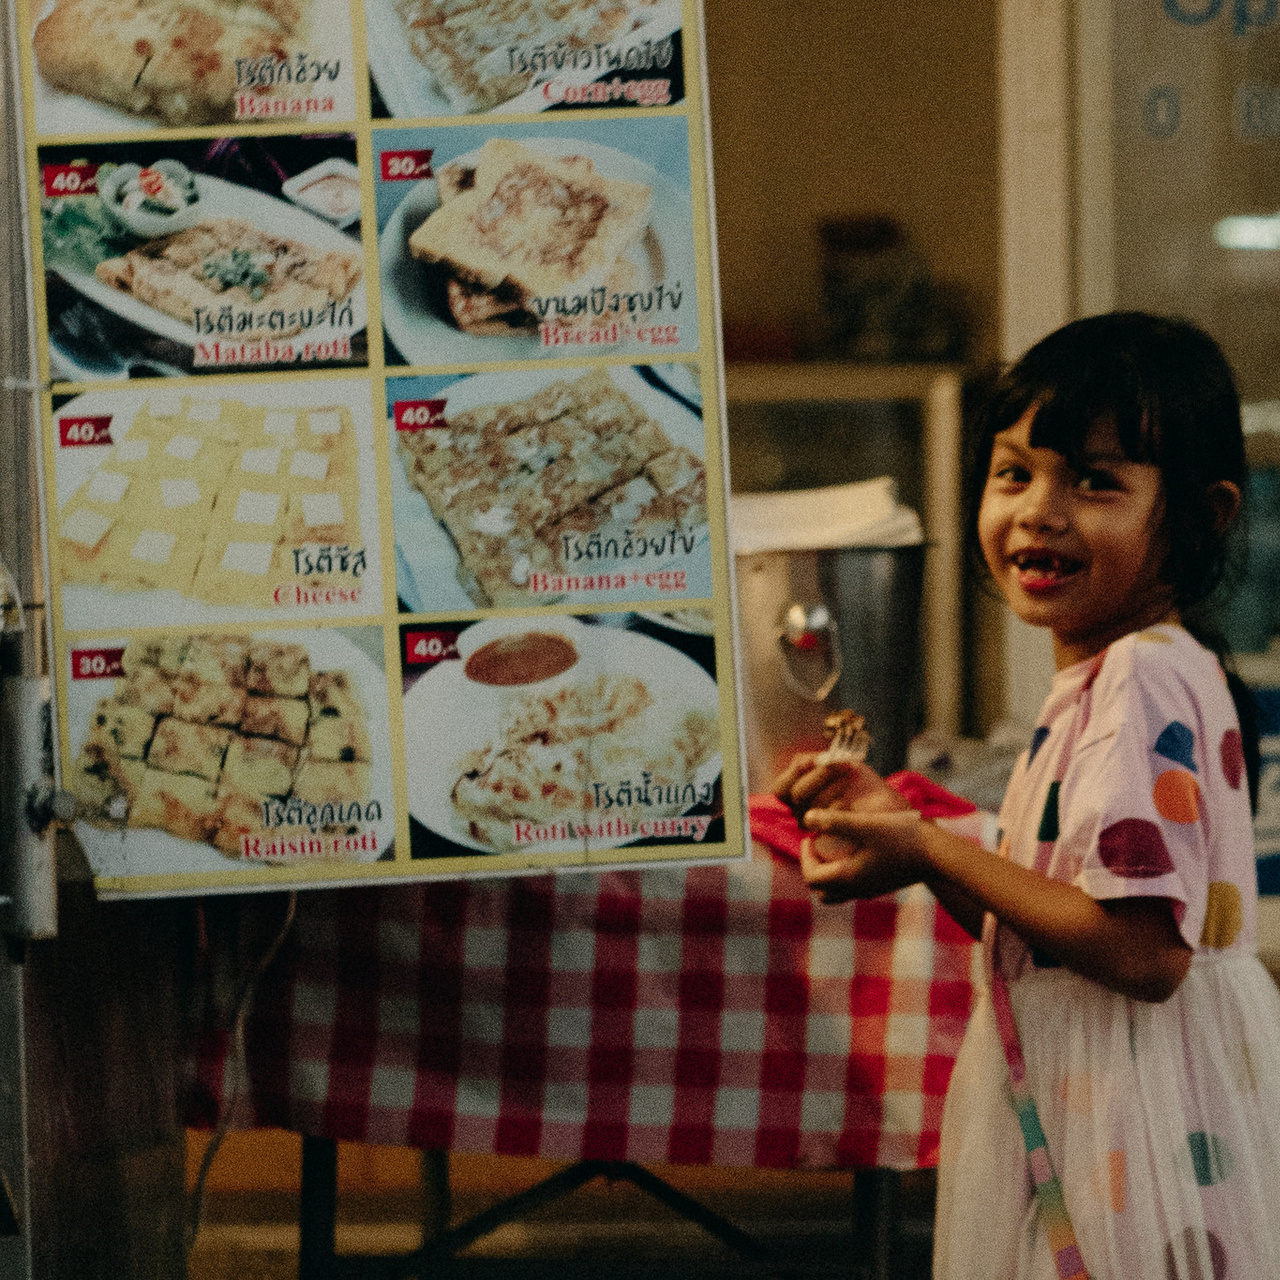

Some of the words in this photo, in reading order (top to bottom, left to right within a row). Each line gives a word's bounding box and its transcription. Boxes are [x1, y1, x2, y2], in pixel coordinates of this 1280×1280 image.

[237, 94, 336, 117] Banana
[195, 340, 295, 365] Mataba
[303, 335, 352, 359] roti
[272, 582, 363, 607] Cheese
[513, 820, 568, 843] Roti
[572, 817, 633, 841] with
[639, 815, 712, 842] curry
[240, 833, 323, 858] Raisin
[331, 829, 379, 852] roti
